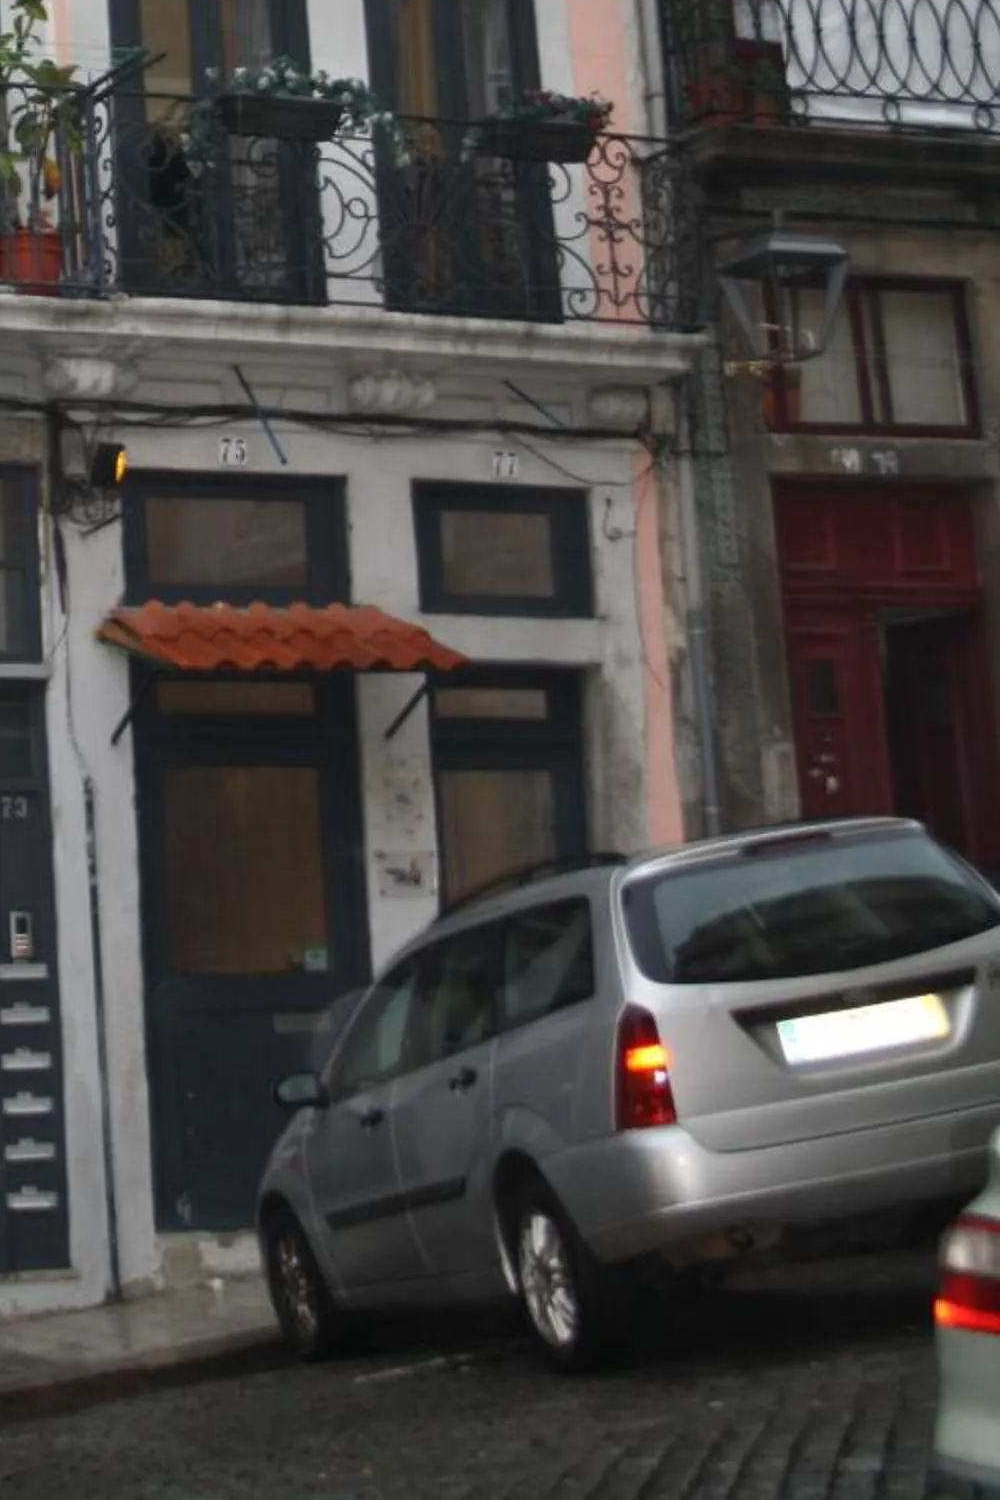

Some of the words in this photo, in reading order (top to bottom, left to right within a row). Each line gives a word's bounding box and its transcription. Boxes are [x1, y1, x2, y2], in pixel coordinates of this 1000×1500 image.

[218, 437, 247, 465] 75
[494, 451, 518, 476] 77
[1, 796, 28, 819] 73
